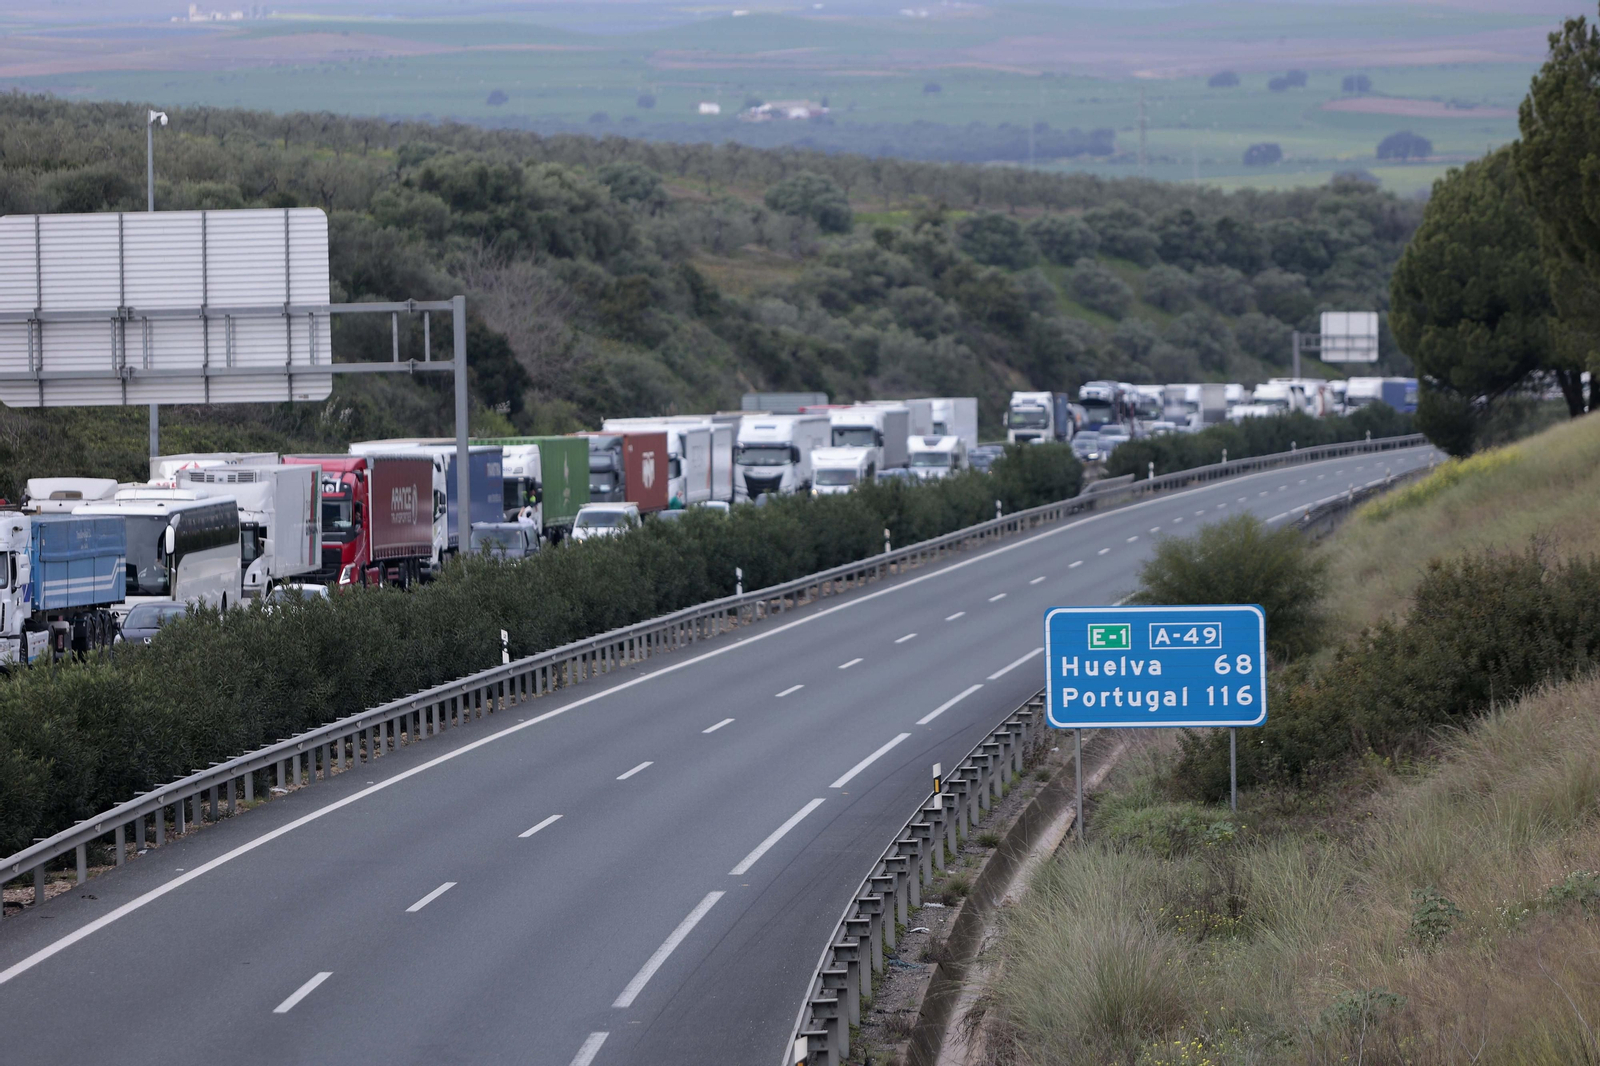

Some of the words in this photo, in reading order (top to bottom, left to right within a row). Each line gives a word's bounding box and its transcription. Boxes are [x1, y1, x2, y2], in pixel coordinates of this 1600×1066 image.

[1092, 628, 1127, 646] E-1
[1154, 626, 1217, 645] A-49
[1061, 655, 1162, 677] Huelva
[1214, 653, 1253, 675] 68
[1062, 685, 1188, 712] Portugal
[1206, 684, 1253, 706] 116
